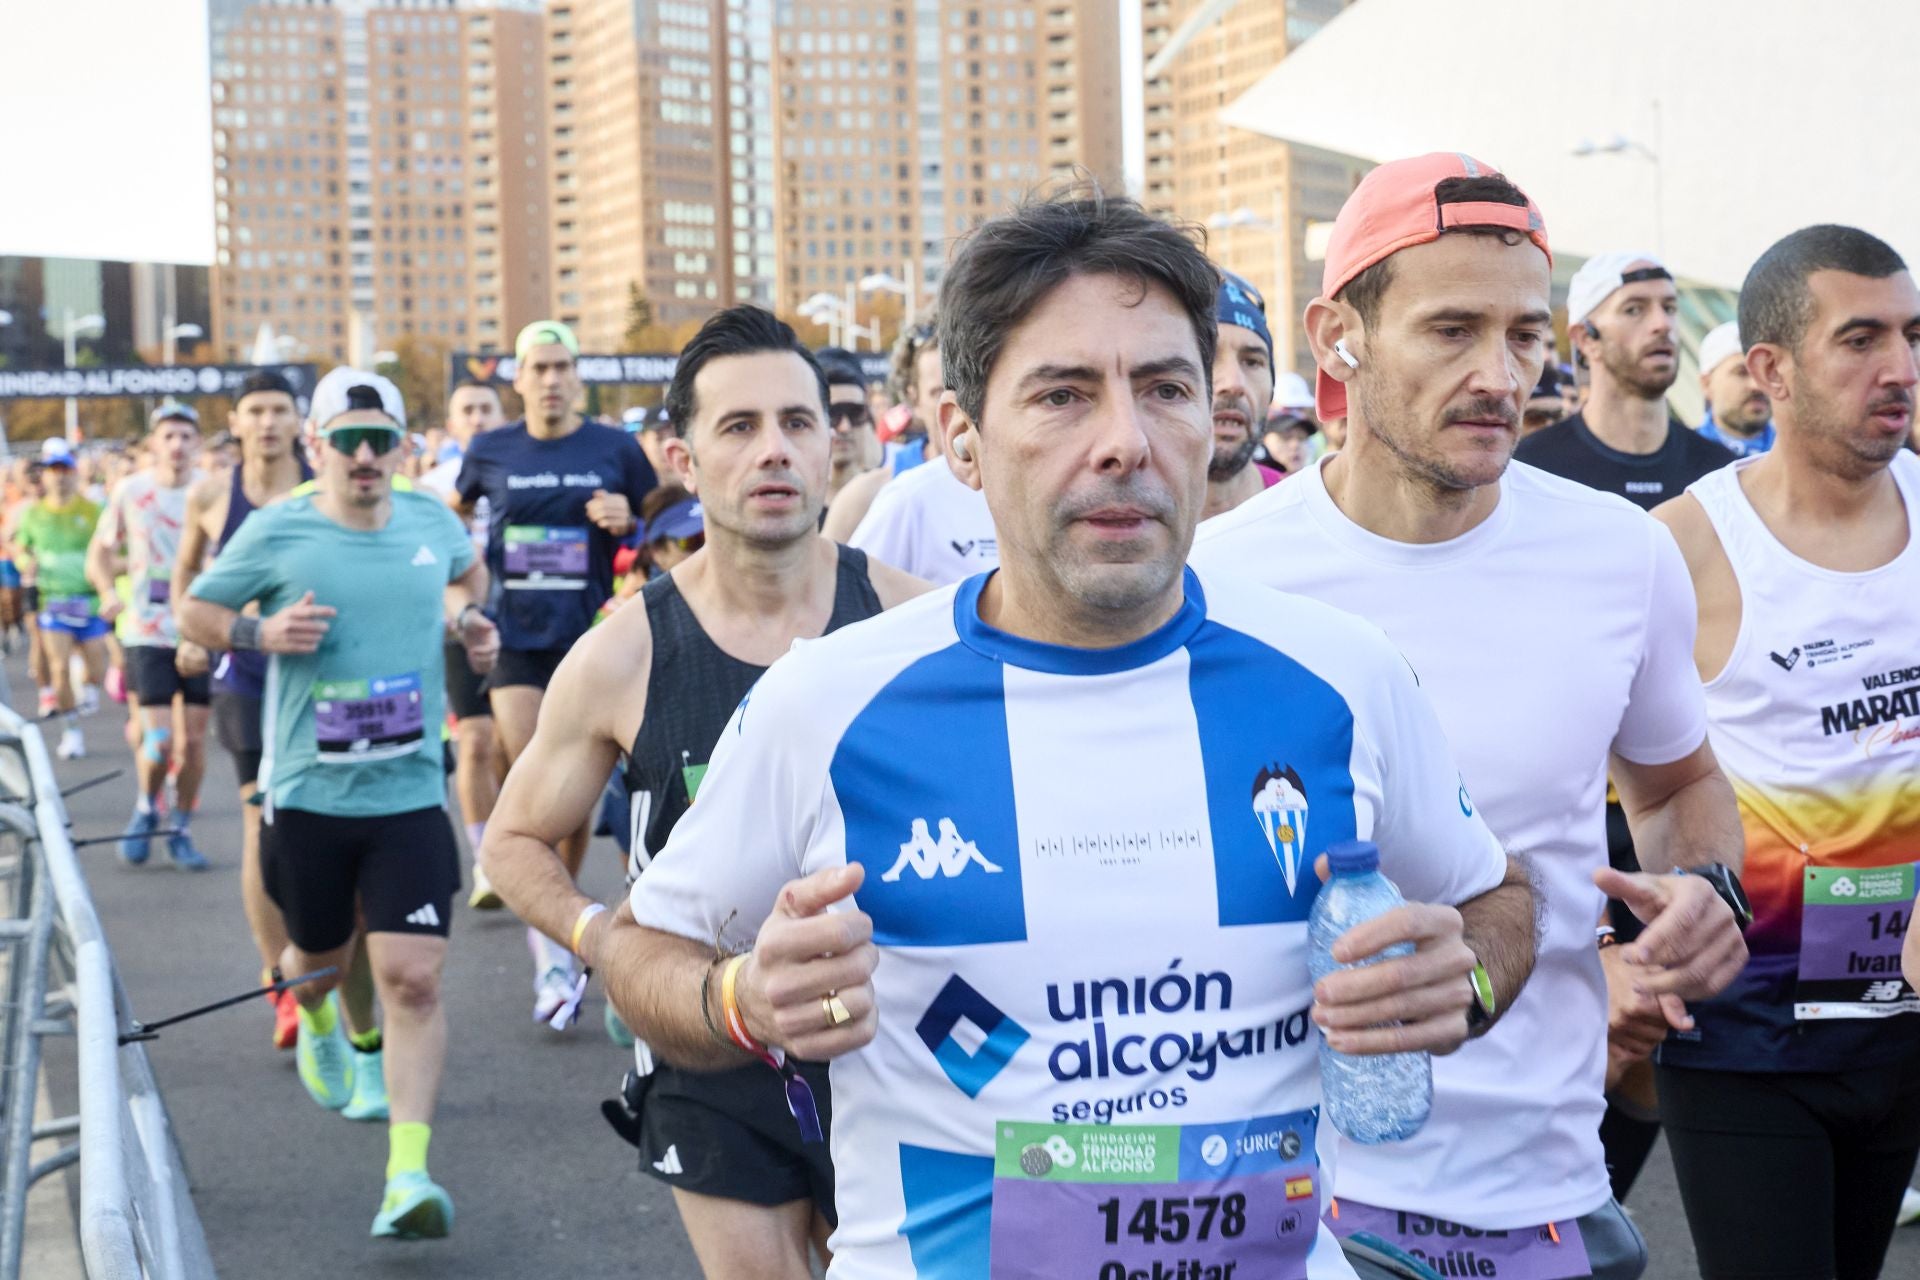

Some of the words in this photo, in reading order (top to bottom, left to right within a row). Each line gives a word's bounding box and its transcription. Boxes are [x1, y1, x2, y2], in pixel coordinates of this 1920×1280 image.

[86, 368, 198, 395] ALFONSO
[1867, 911, 1911, 940] 14
[1046, 958, 1232, 1022] unión
[1048, 1006, 1310, 1082] alcoyana
[1052, 1086, 1188, 1125] seguros
[1081, 1143, 1156, 1160] TRINIDAD
[1236, 1126, 1291, 1157] URIC
[1081, 1158, 1155, 1174] ALFONSO
[1098, 1192, 1246, 1244] 14578
